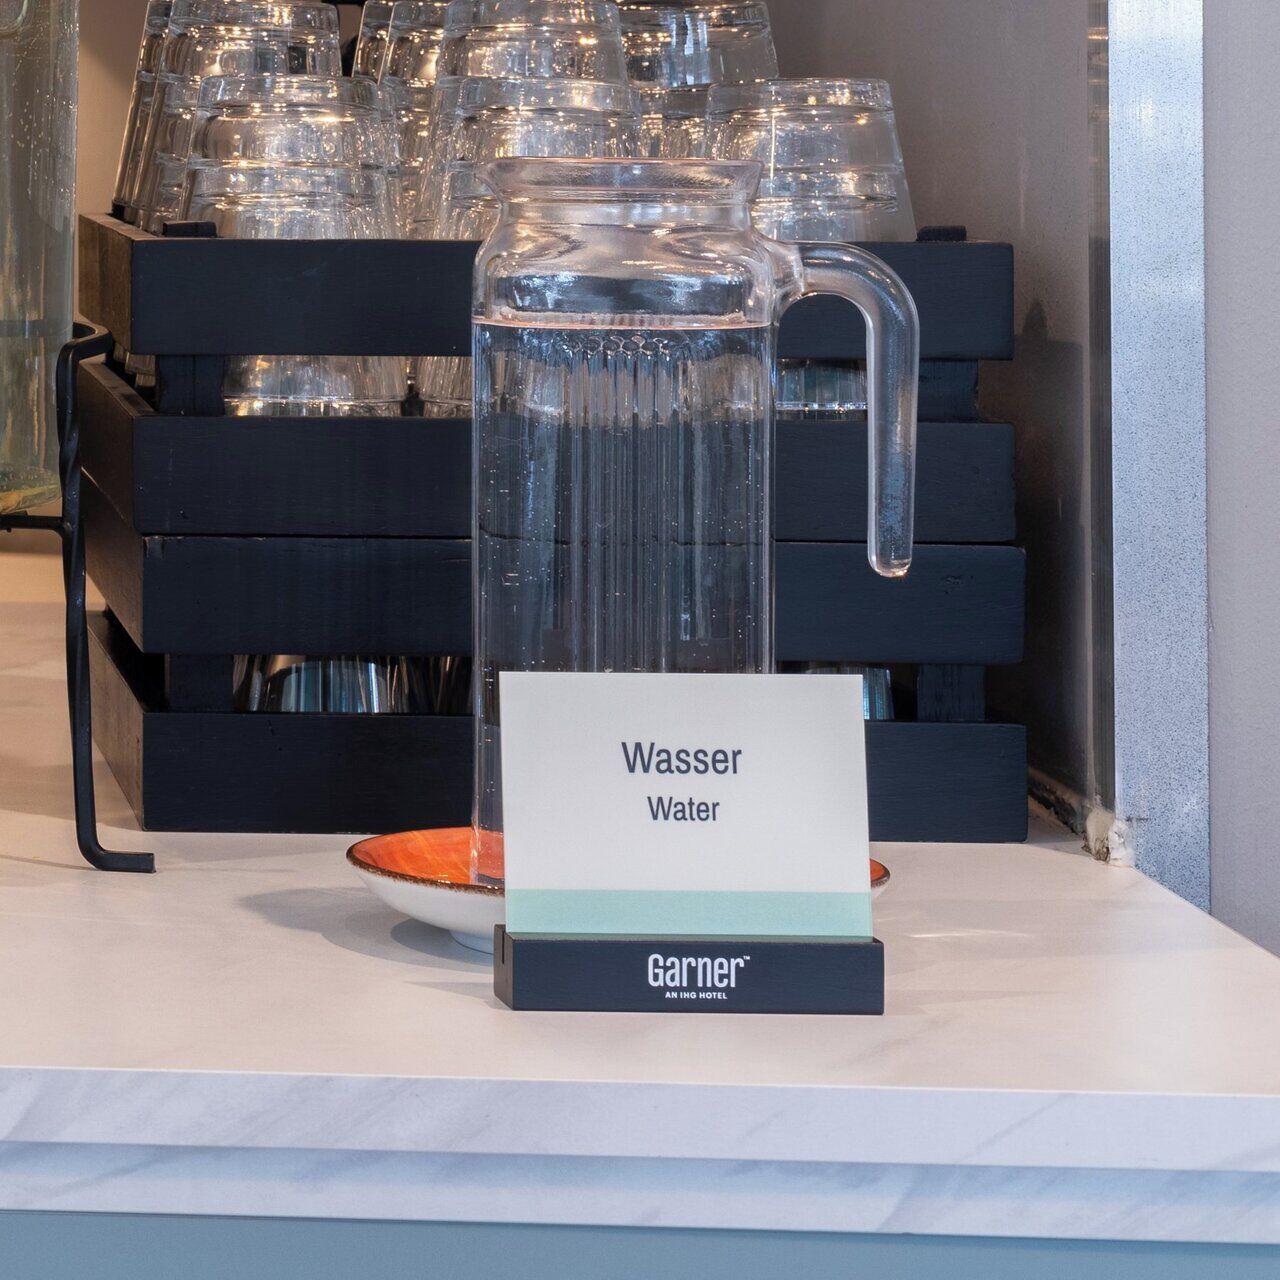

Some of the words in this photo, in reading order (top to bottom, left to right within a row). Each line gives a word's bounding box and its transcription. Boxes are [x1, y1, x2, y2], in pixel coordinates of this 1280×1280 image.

[621, 741, 742, 775] Wasser
[647, 796, 720, 822] Water
[665, 991, 678, 999] AN
[680, 991, 697, 999] IHG
[699, 992, 728, 1000] HOTEL
